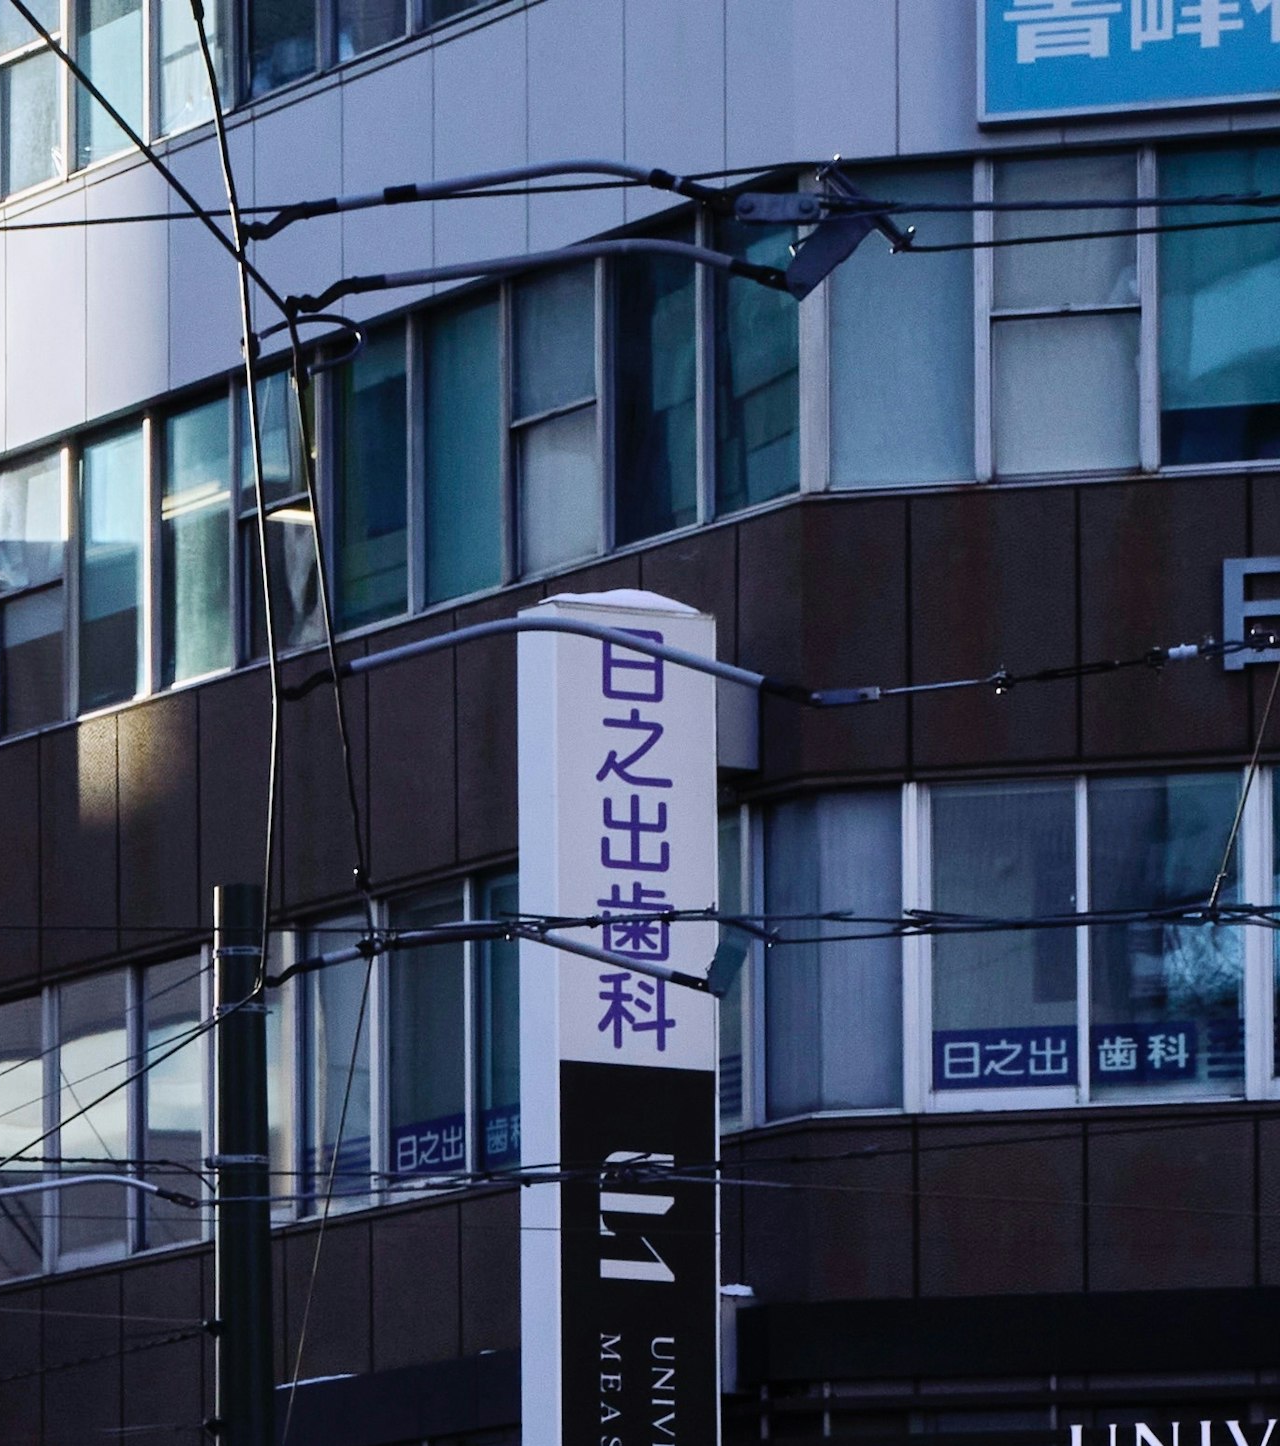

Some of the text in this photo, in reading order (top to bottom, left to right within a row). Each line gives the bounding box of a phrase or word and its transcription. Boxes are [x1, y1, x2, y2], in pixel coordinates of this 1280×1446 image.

[597, 628, 677, 1052] 日之出歯科
[944, 1033, 1189, 1079] 日之出歯科
